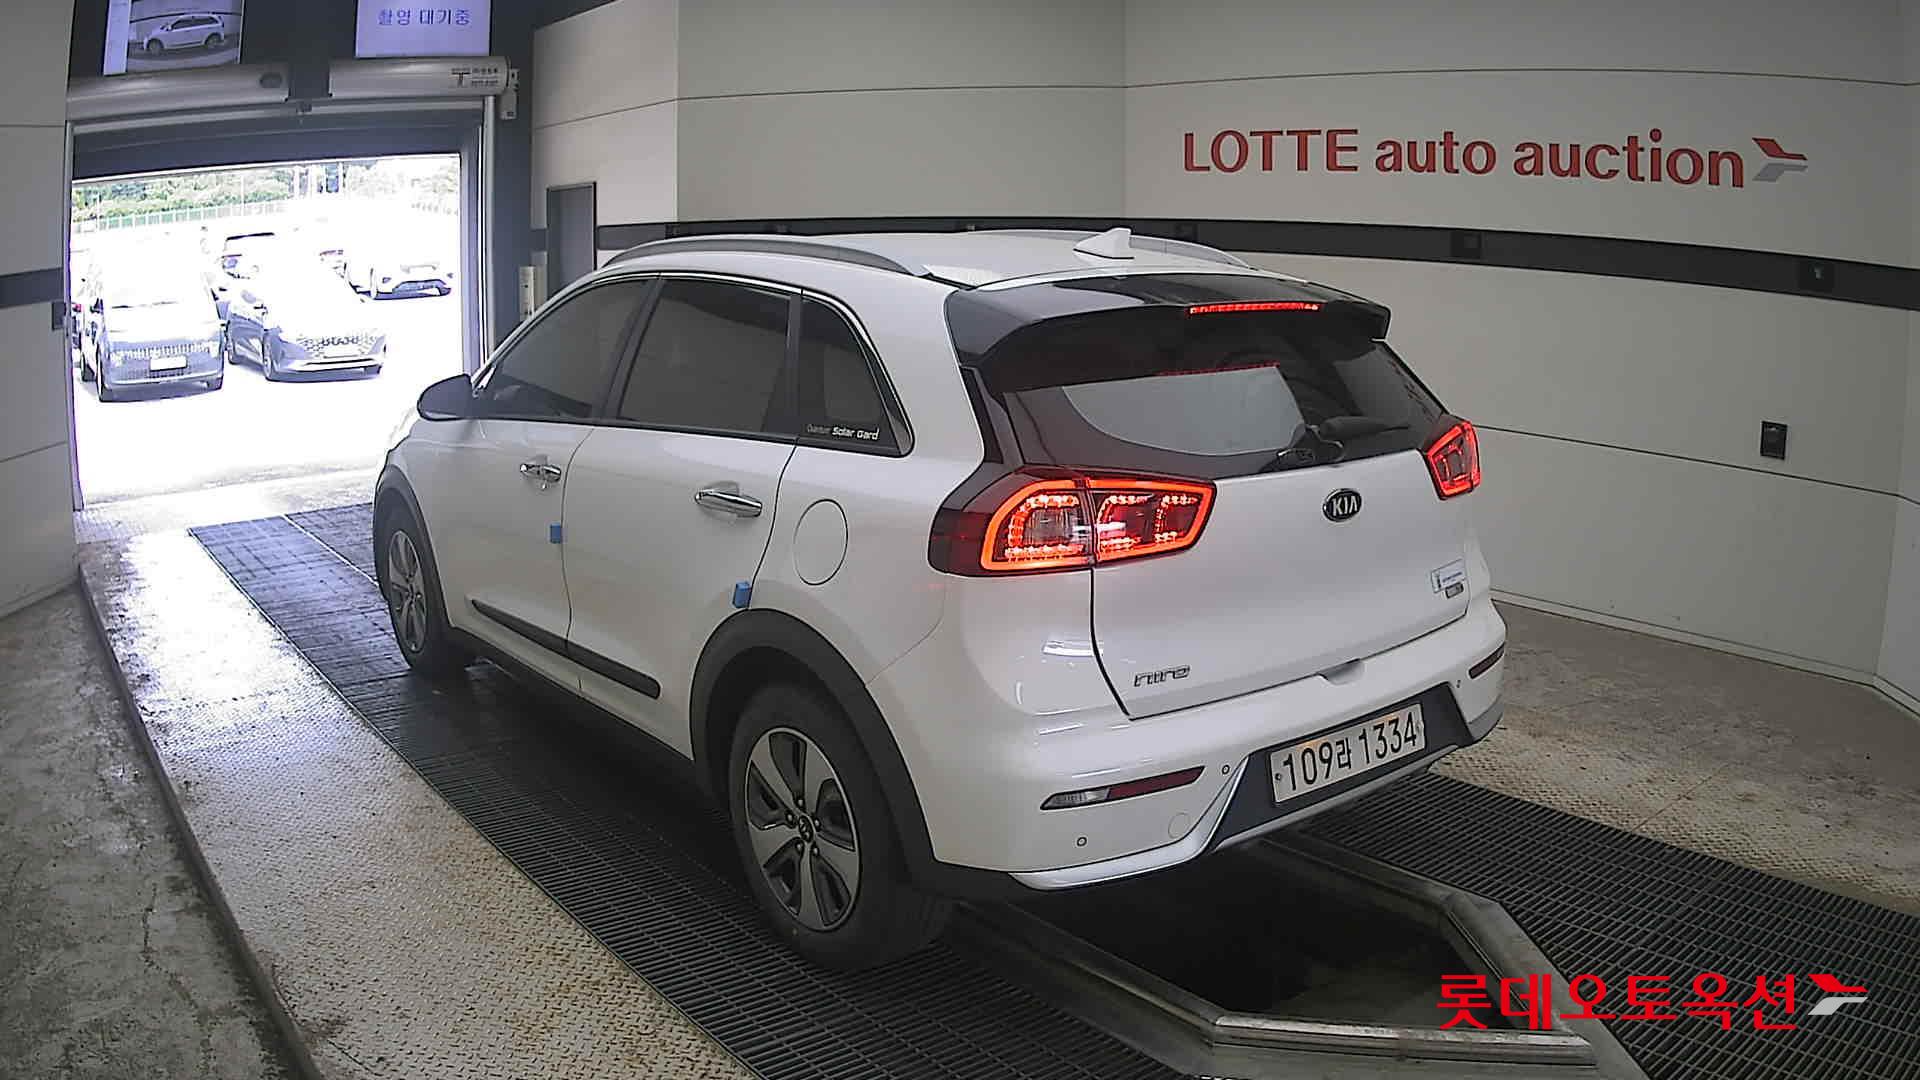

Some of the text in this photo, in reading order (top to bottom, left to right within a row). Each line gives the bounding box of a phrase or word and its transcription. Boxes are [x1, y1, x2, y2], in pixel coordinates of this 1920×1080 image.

[420, 9, 471, 26] 대기중
[1184, 128, 1744, 188] LOTTE auto auction
[857, 428, 880, 440] Gard
[1332, 495, 1358, 516] KIA
[1282, 711, 1418, 792] 109라 1334
